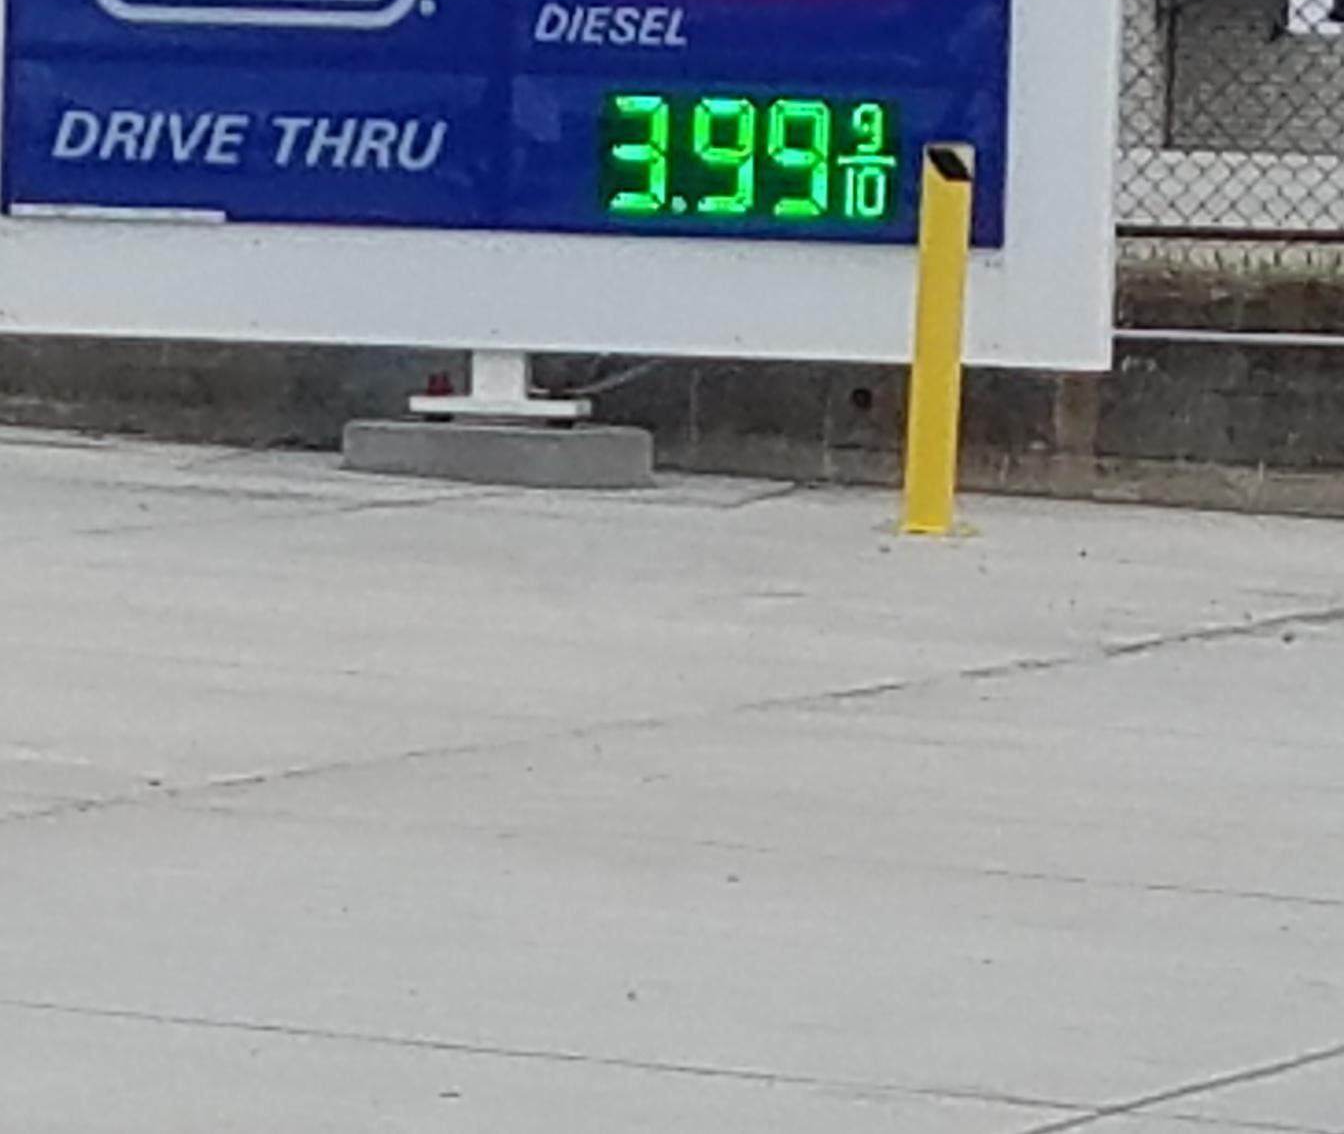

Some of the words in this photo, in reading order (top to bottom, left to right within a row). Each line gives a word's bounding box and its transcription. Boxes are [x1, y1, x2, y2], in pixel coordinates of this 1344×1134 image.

[534, 3, 688, 47] DIESEL
[51, 109, 249, 165] DRIVE
[272, 116, 448, 171] THRU
[608, 95, 832, 216] 3.99
